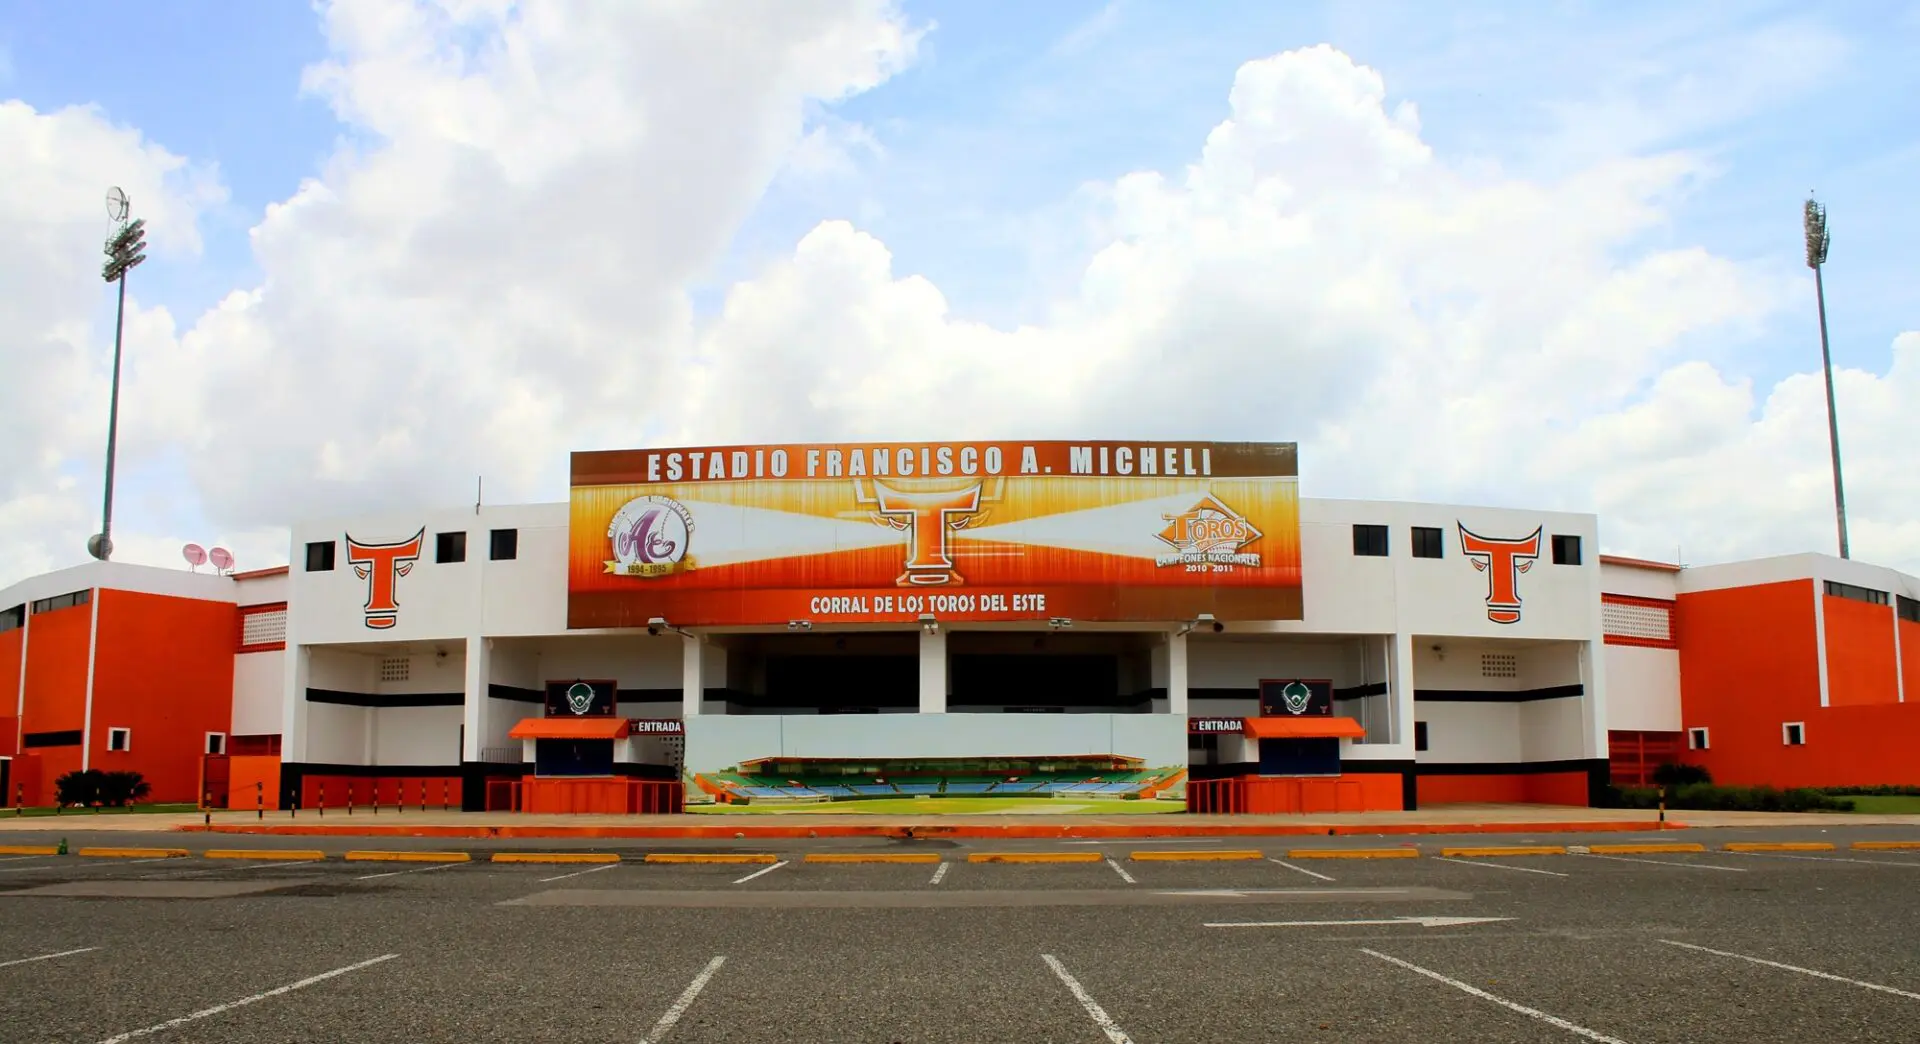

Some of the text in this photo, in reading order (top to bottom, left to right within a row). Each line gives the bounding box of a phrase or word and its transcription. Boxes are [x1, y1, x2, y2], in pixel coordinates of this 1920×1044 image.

[647, 446, 1212, 482] ESTADIO FRANCISCO A. MICHELI
[1161, 509, 1247, 548] TOROS
[1156, 553, 1261, 567] CAMPEONES NACIONALES
[1185, 565, 1233, 573] 2010 2011
[811, 594, 1046, 614] CORRAL DE LOS TOROS DEL ESTE
[638, 721, 681, 732] ENTRADA
[1199, 720, 1243, 731] ENTRADA
